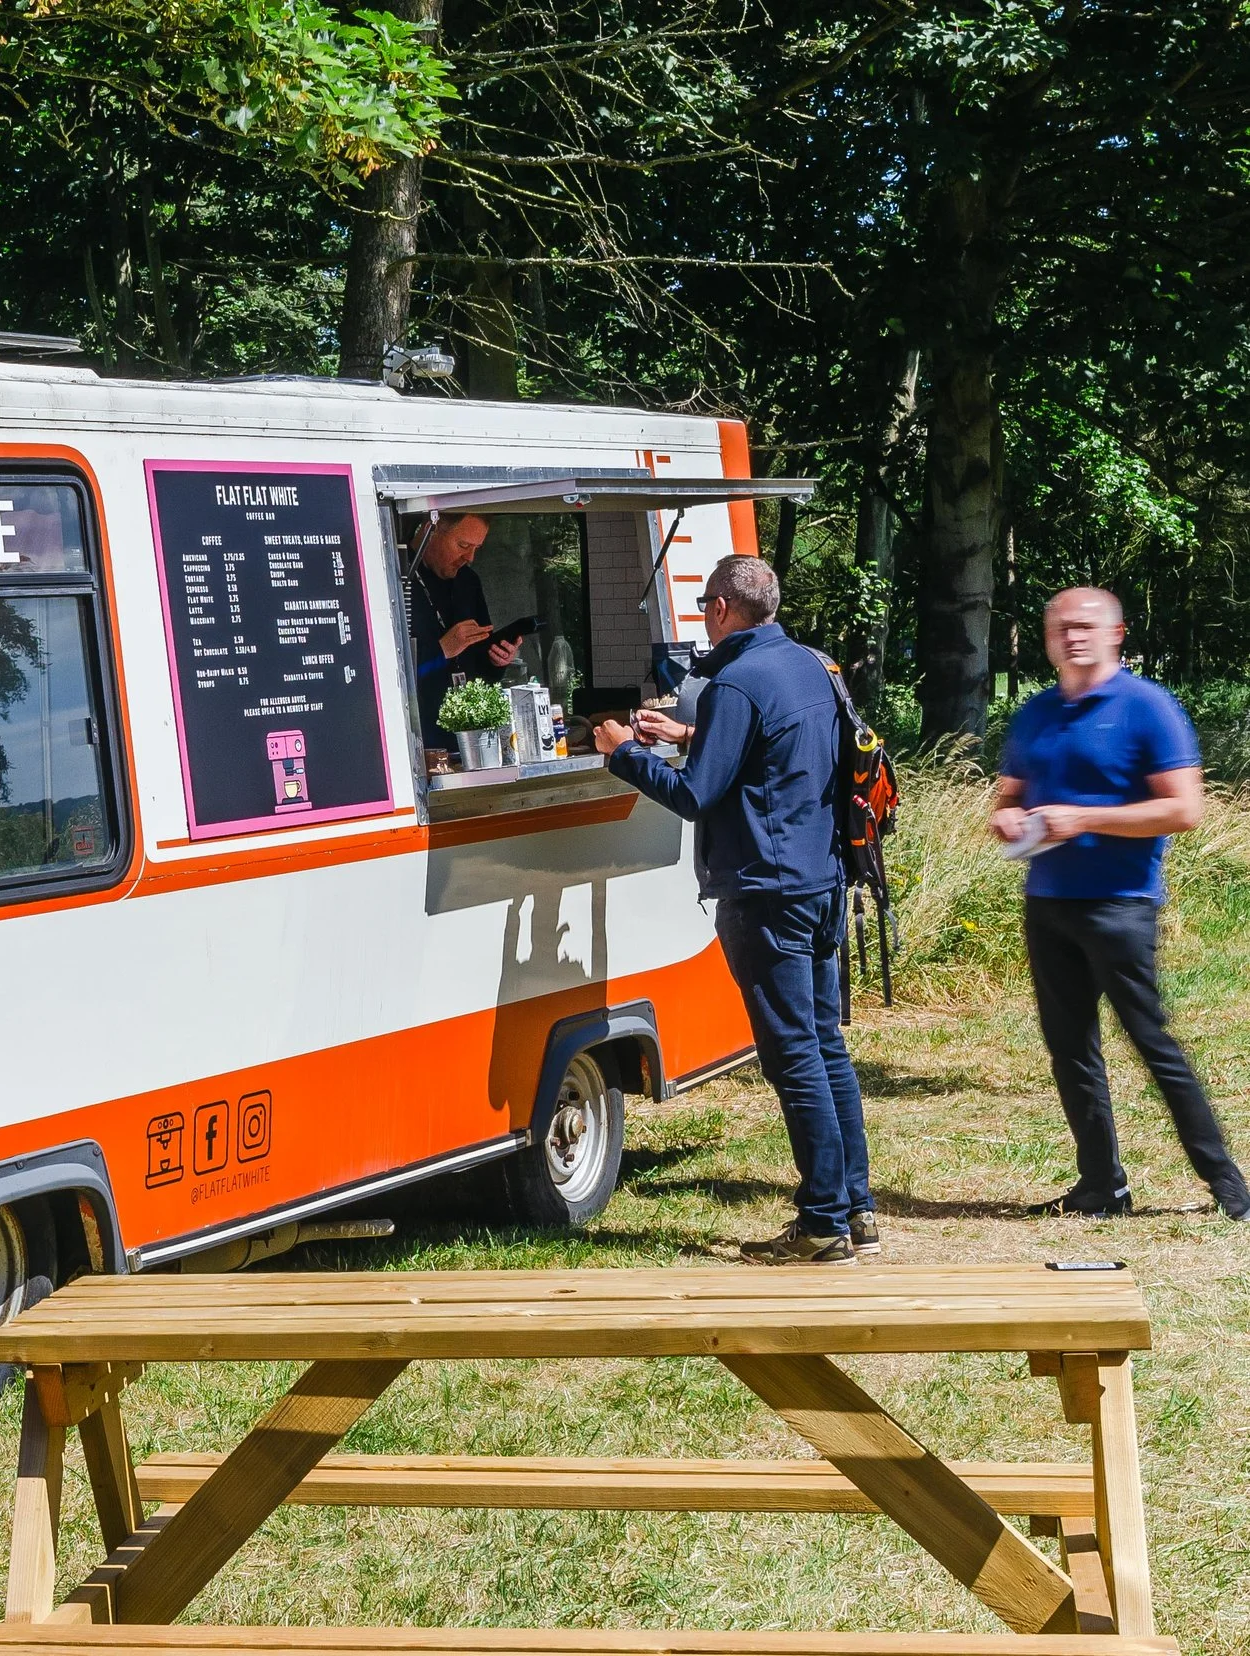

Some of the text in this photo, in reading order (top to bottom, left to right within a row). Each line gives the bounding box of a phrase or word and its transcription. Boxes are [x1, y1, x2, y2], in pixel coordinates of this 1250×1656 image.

[215, 485, 299, 506] FLAT FLAT WHITE
[246, 512, 275, 520] COFFEE BAR
[201, 535, 222, 546] COFFEE
[264, 535, 281, 545] SWEET
[303, 535, 319, 544] CAKES
[325, 535, 340, 544] BAKES
[284, 600, 339, 611] CIABATTA SANDWICHES
[302, 654, 334, 665] LUNCH OFFER
[260, 695, 306, 706] FOR ALLERGEN ADVICE
[244, 707, 261, 716] PLEASE
[261, 707, 275, 715] SPEAK
[276, 706, 281, 714] TO
[287, 704, 303, 713] MEMBER
[310, 703, 323, 711] STAFF
[191, 1165, 270, 1205] @FLATFLATWHITE
